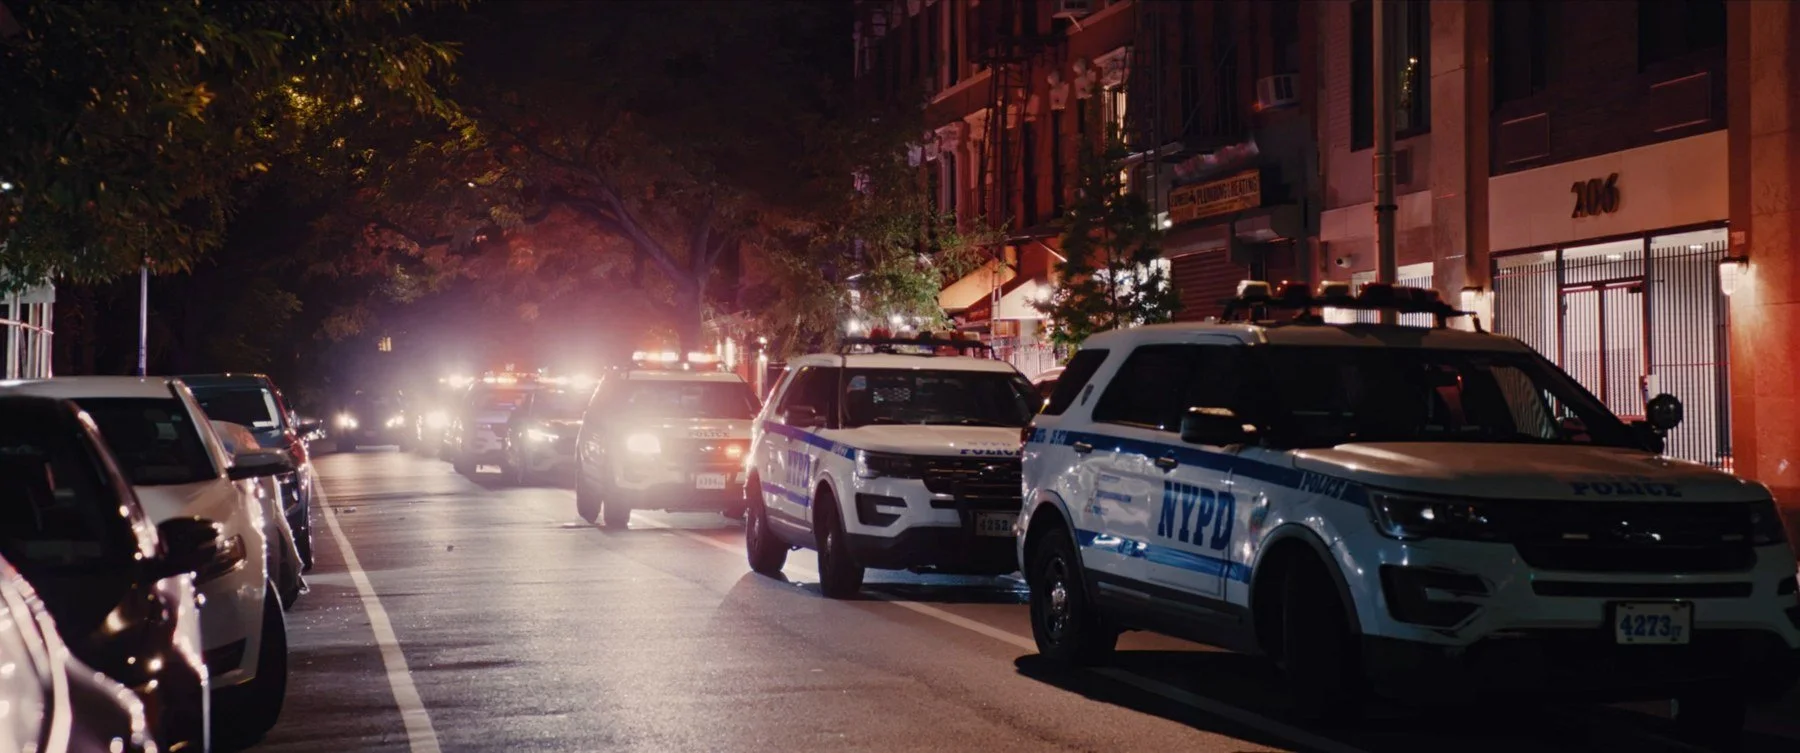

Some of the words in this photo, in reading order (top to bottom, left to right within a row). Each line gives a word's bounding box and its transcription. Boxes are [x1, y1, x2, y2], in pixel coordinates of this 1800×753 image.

[1571, 173, 1620, 218] 206
[786, 450, 810, 488] NYPD
[1300, 471, 1346, 499] POLICE
[1568, 481, 1682, 498] POLICE
[1157, 480, 1236, 550] NYPD
[1620, 614, 1672, 637] 4273
